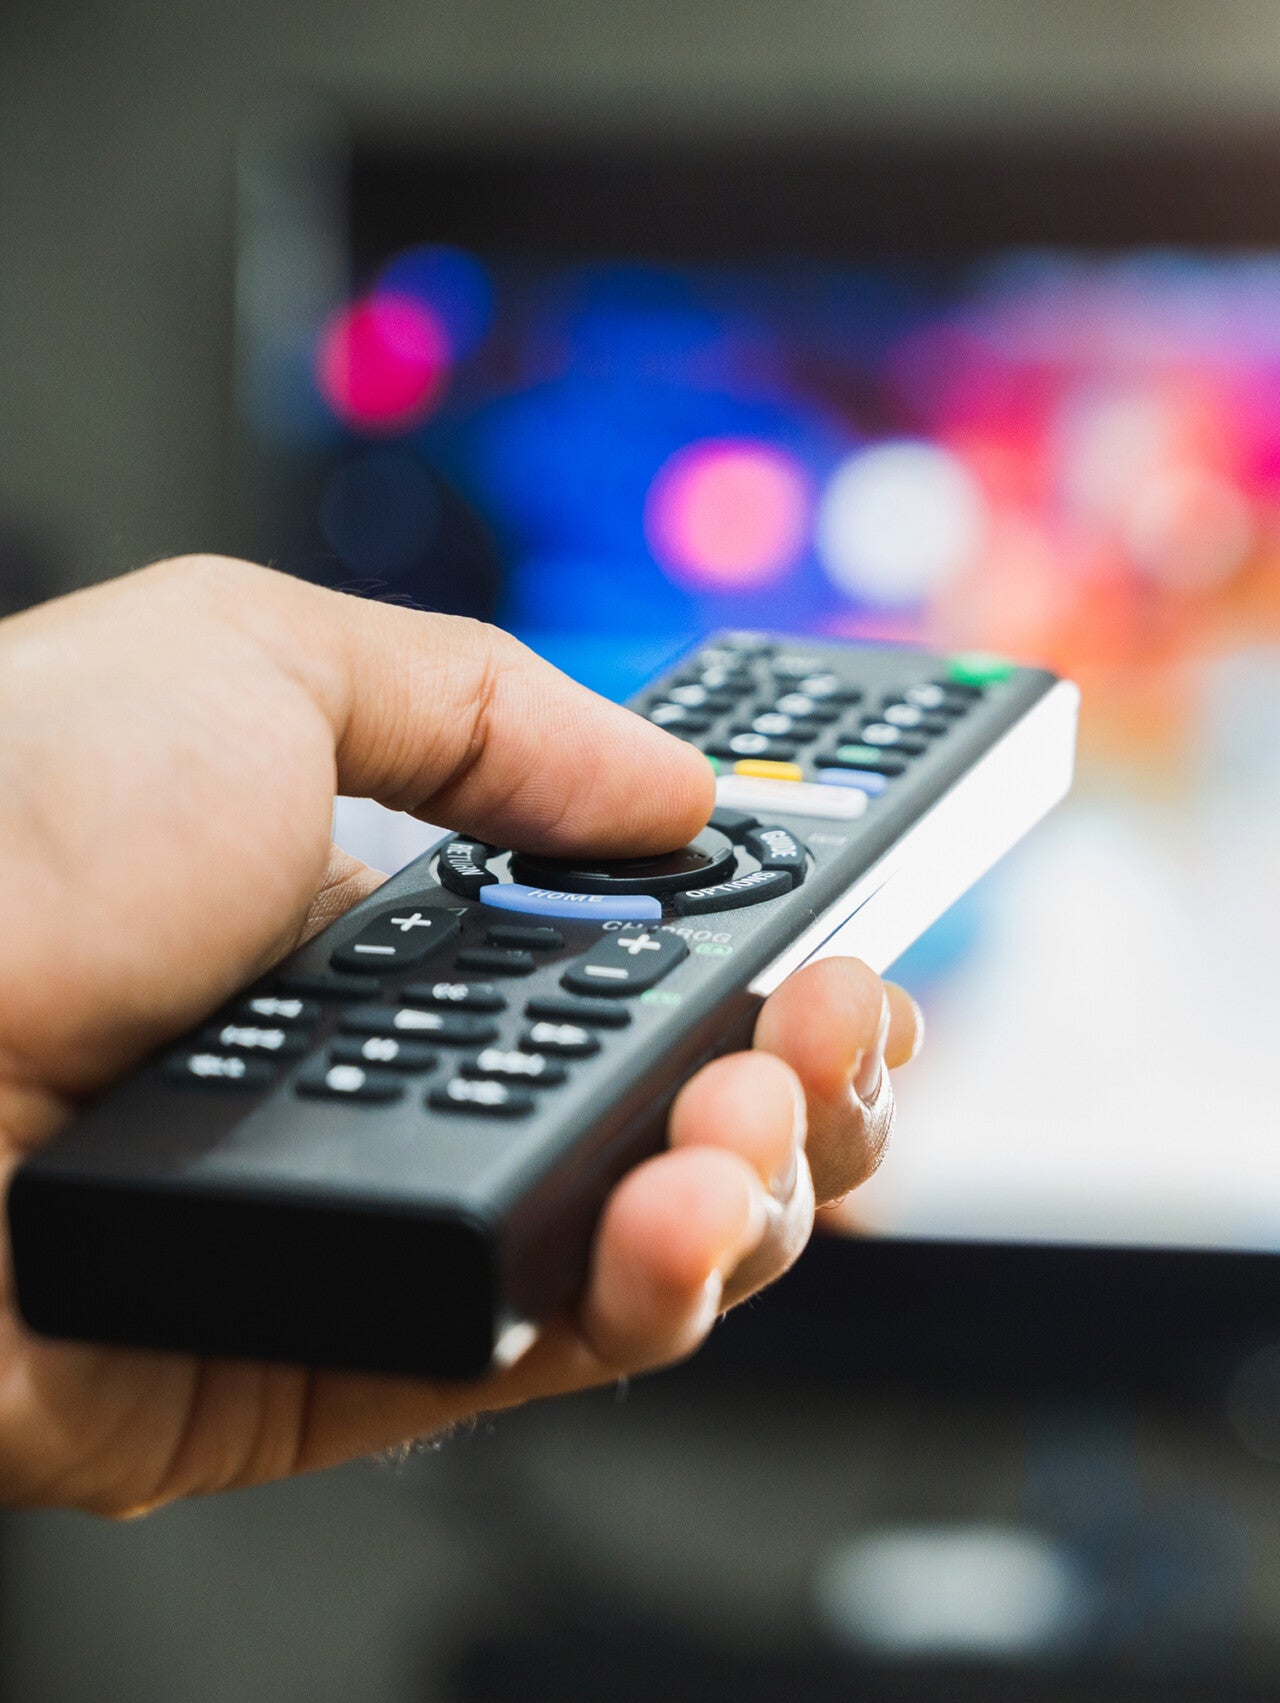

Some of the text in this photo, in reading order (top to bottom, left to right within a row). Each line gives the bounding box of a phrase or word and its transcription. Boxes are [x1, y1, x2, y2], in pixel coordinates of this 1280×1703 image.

[760, 830, 797, 858] GUIDE
[446, 843, 485, 875] RETURN
[527, 889, 606, 903] HOME
[685, 871, 778, 898] OPTIONS
[602, 920, 732, 943] CHPROG
